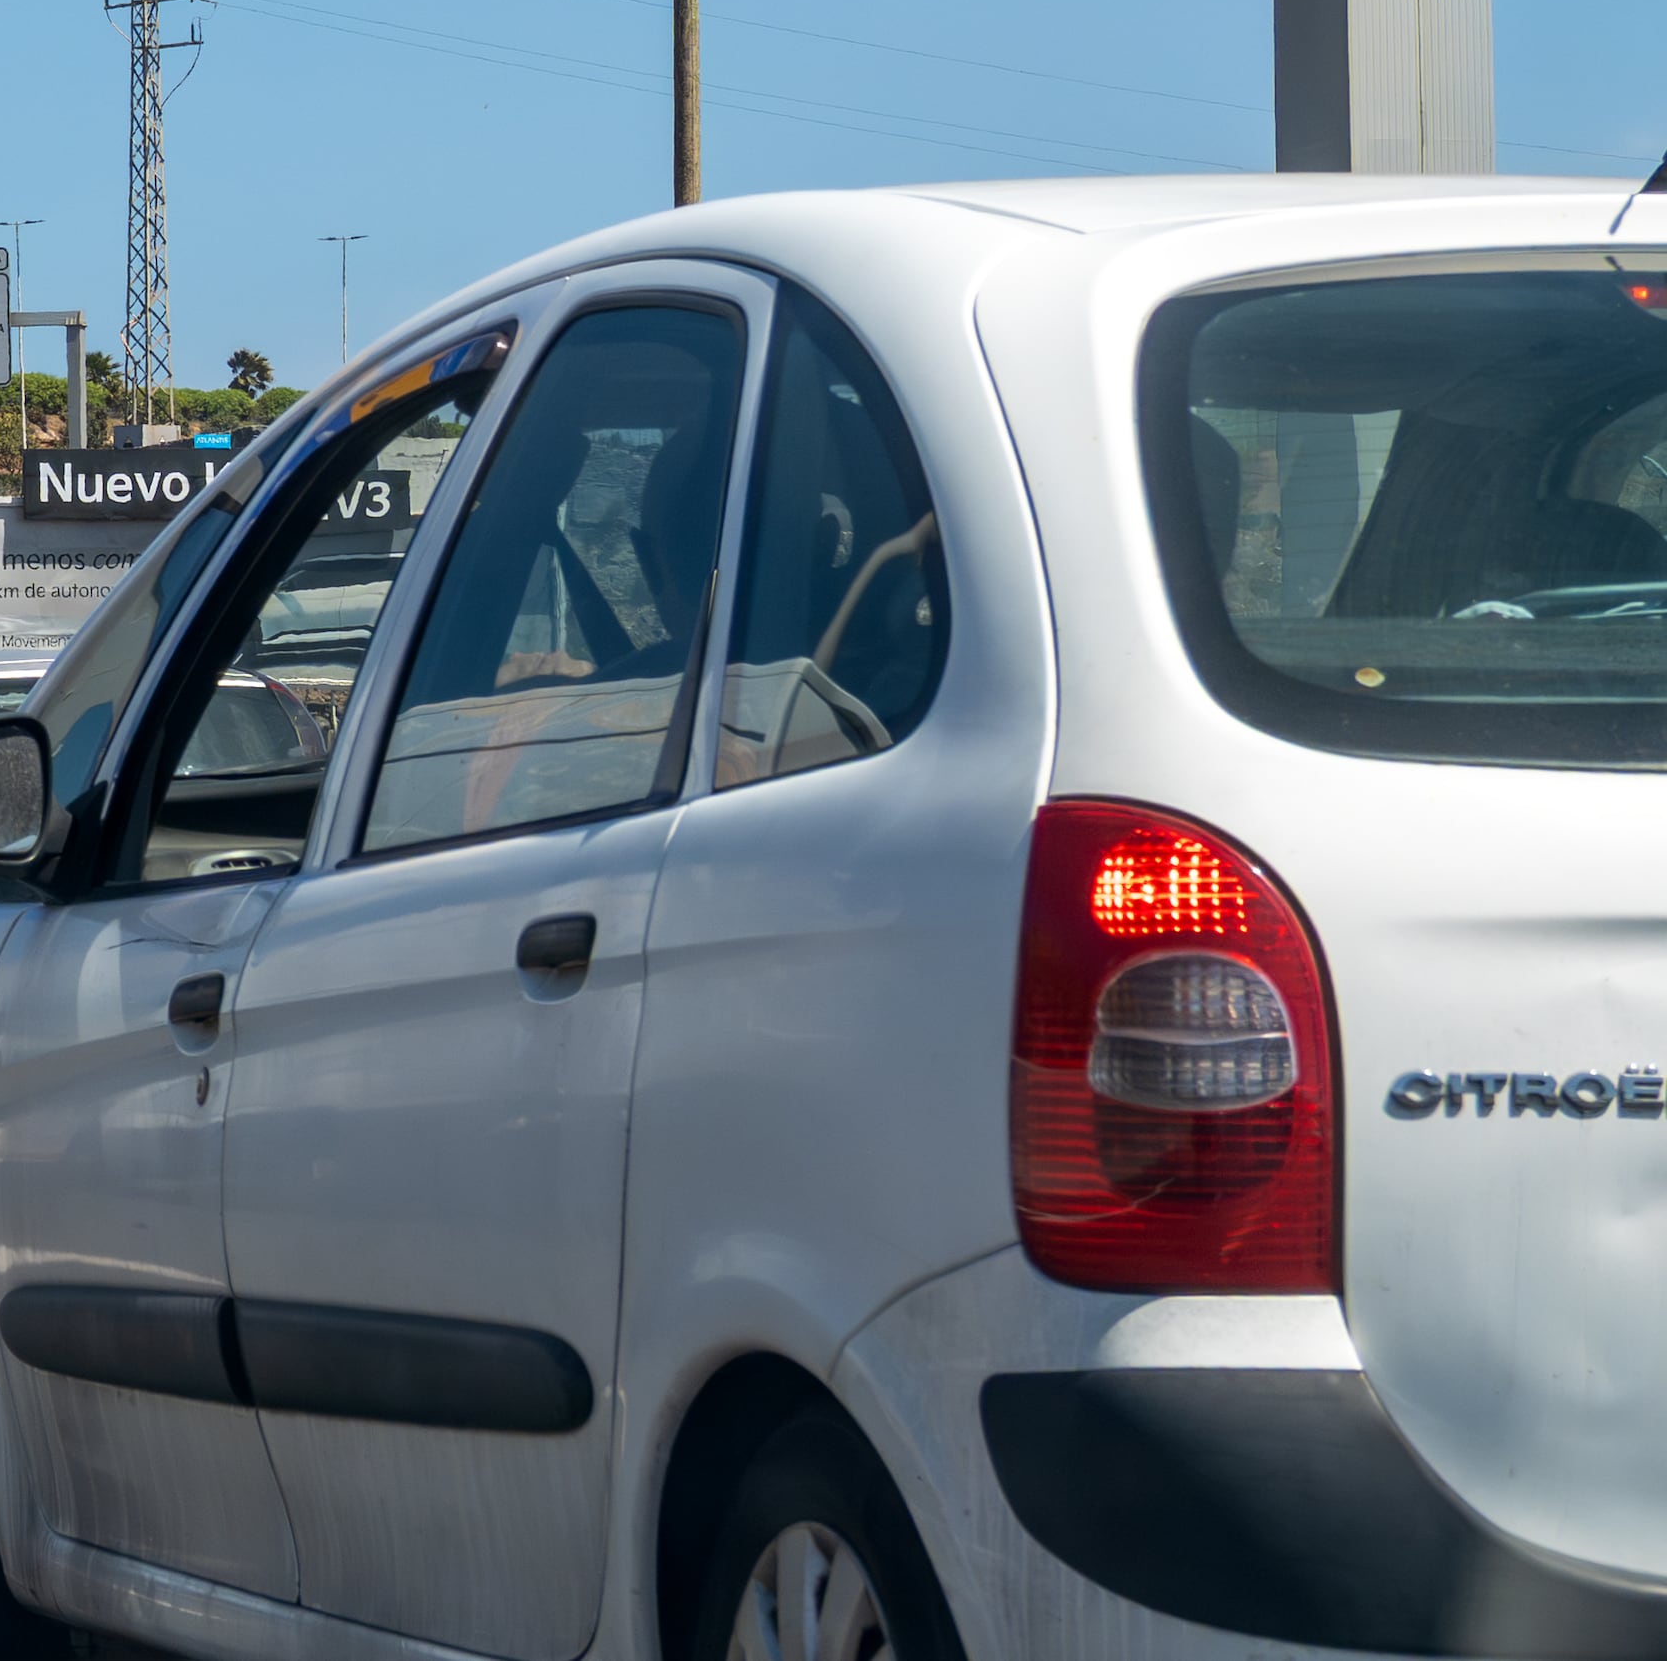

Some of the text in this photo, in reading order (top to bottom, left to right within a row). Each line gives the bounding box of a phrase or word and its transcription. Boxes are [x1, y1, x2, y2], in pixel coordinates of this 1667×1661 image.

[39, 461, 190, 504] Nuevo
[321, 480, 392, 521] V3
[2, 550, 86, 571] menos
[92, 552, 143, 570] com
[24, 582, 46, 599] de
[51, 583, 112, 599] autono
[1387, 1061, 1667, 1115] CITROË
